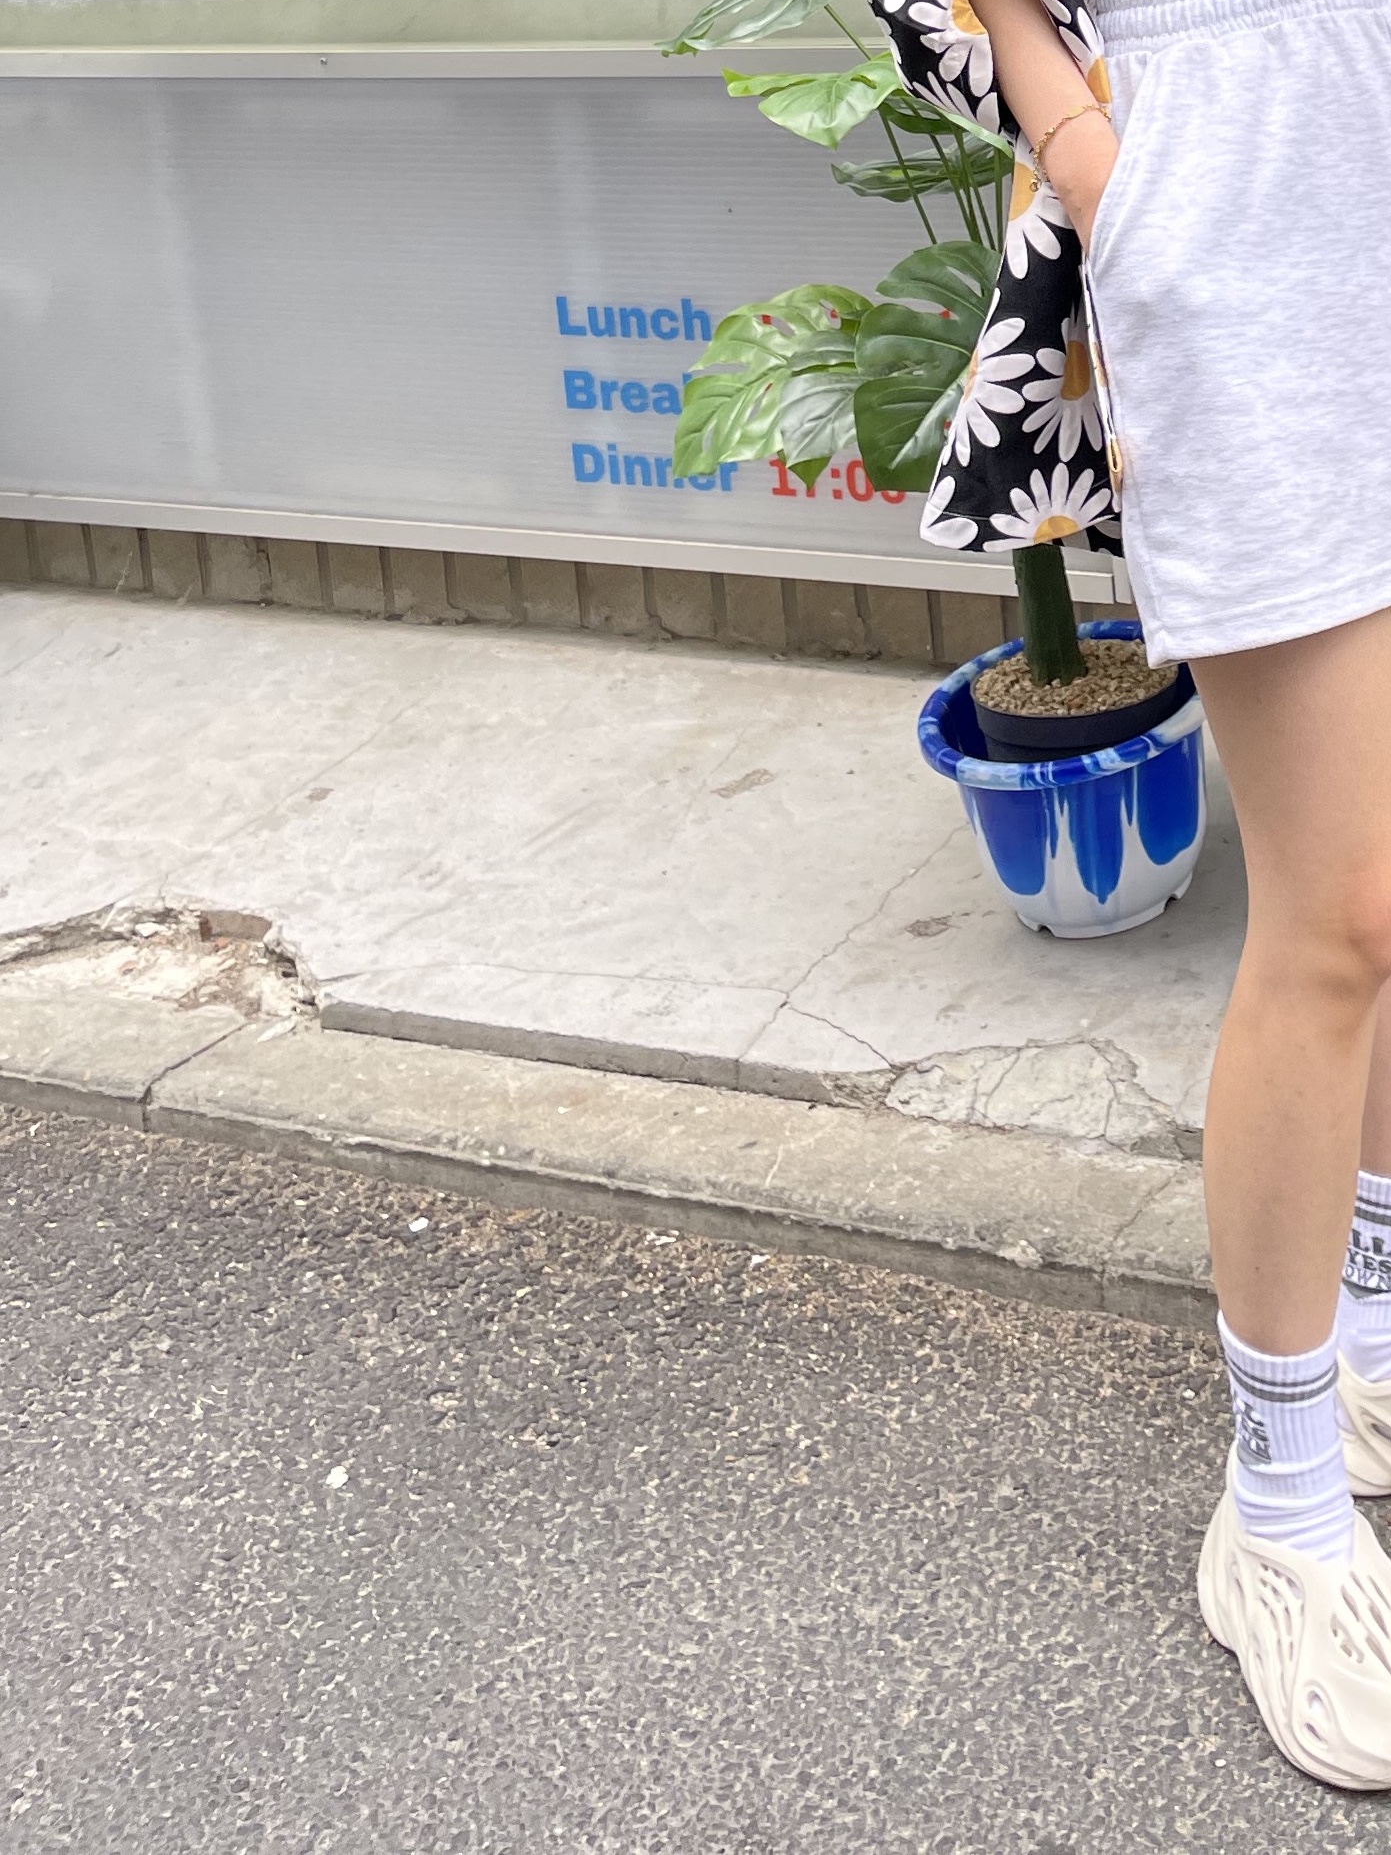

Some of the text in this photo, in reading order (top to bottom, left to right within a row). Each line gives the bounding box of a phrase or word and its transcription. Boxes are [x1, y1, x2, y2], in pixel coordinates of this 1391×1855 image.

[555, 295, 712, 342] Lunch
[562, 369, 689, 416] Brea
[571, 442, 739, 494] Diner
